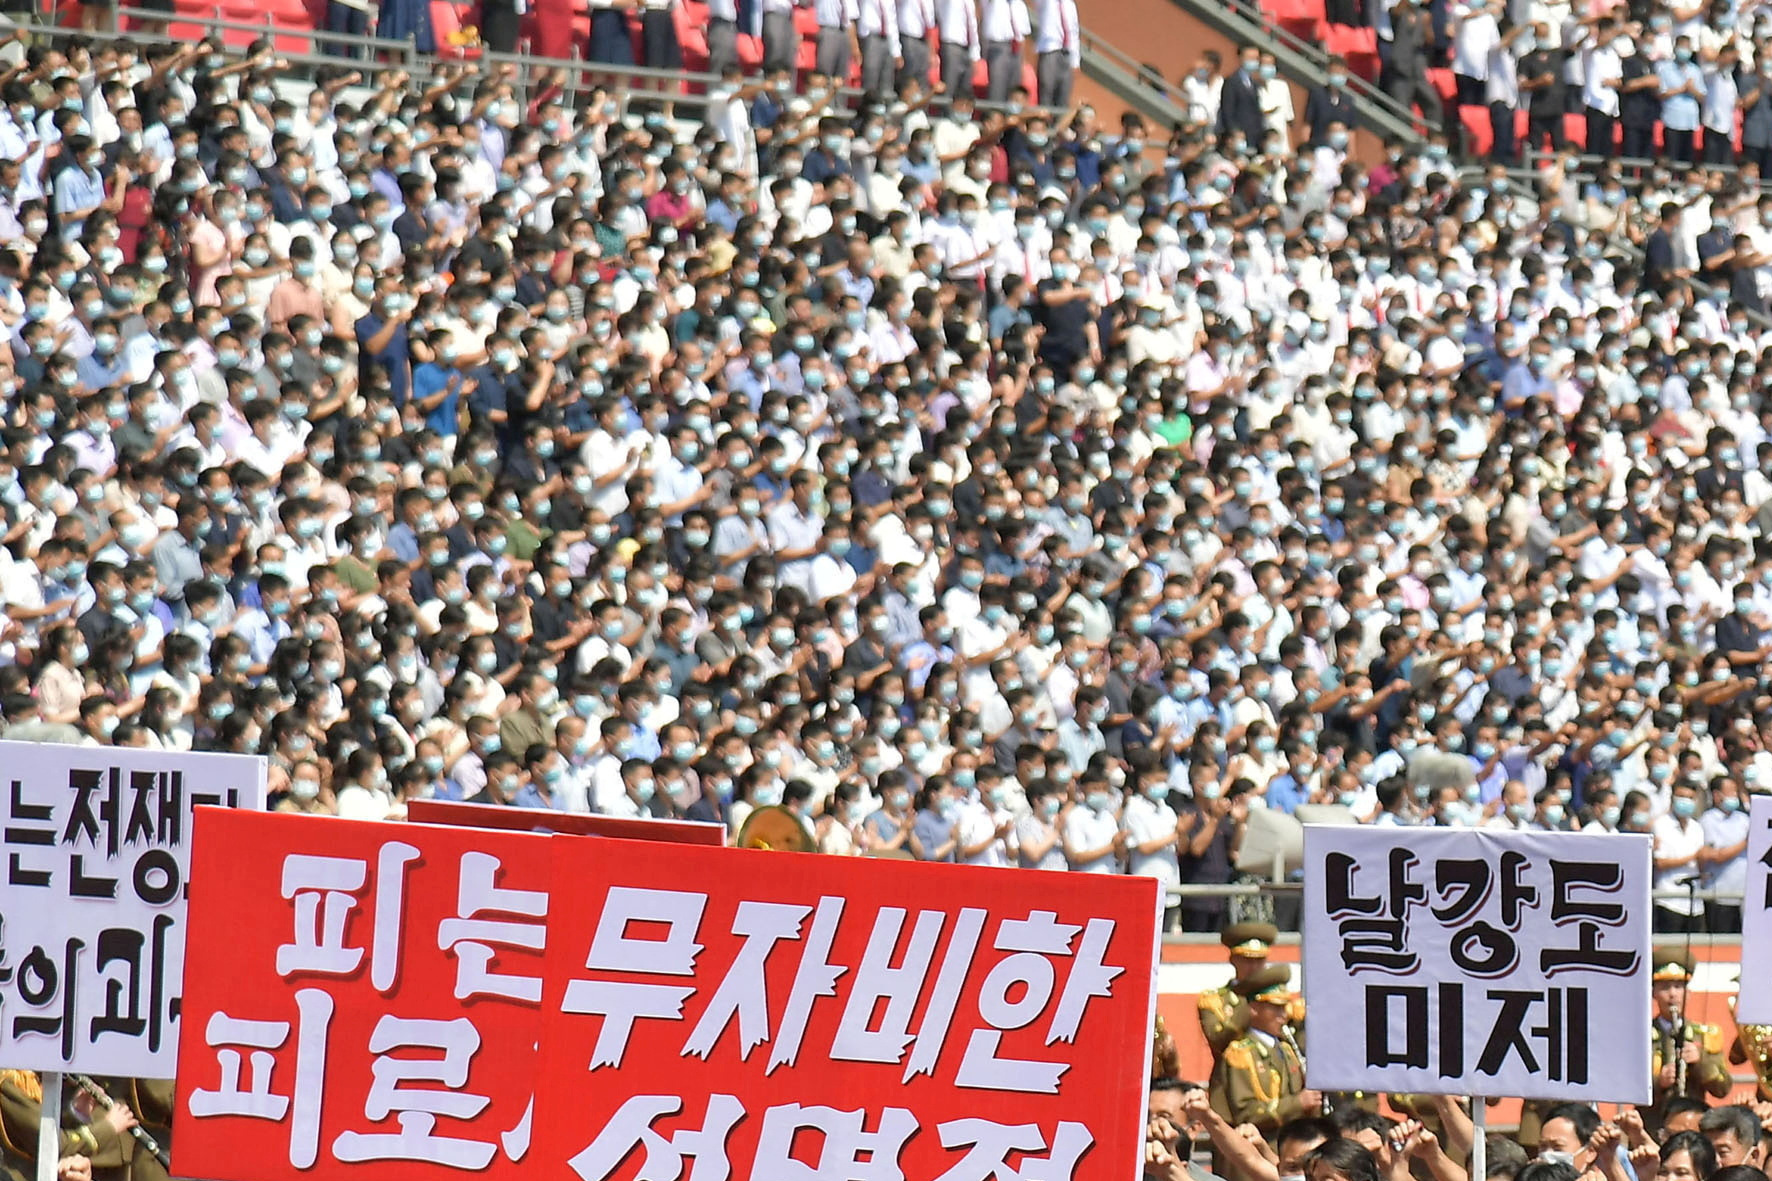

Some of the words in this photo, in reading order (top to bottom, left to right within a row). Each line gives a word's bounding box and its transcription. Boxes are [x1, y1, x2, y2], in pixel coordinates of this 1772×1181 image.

[561, 886, 1126, 1093] 무자비한
[1325, 847, 1641, 979] 날강도
[188, 988, 538, 1170] 피로
[1365, 982, 1589, 1086] 미제
